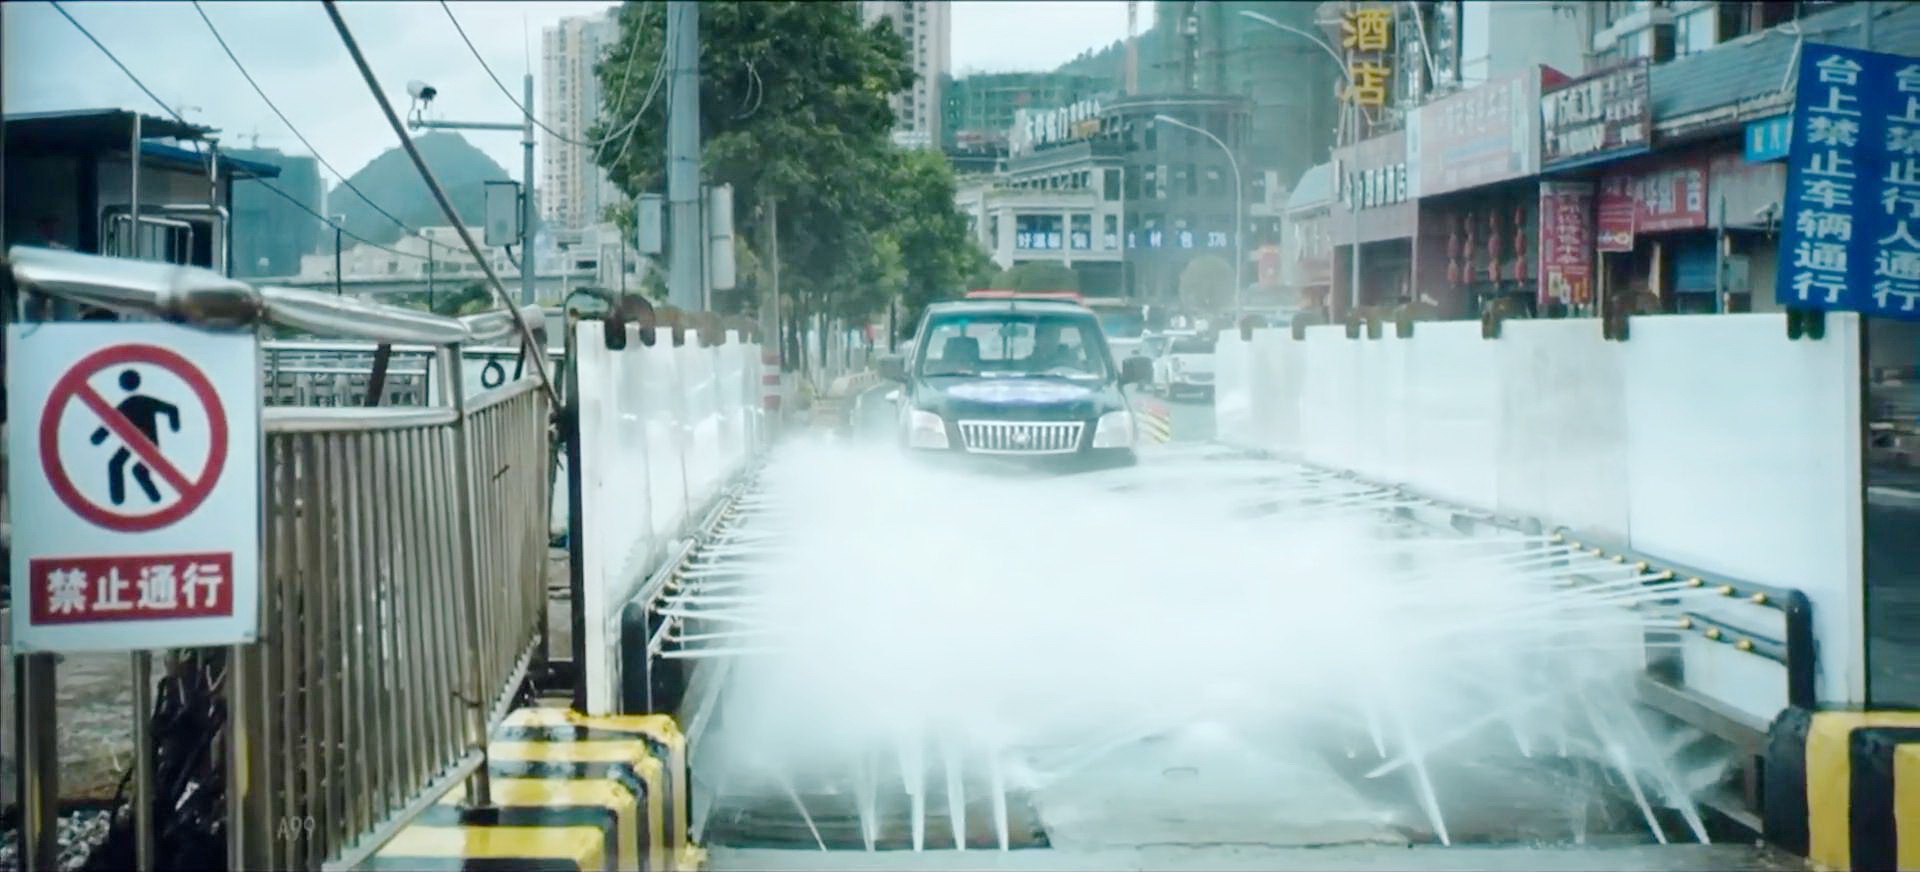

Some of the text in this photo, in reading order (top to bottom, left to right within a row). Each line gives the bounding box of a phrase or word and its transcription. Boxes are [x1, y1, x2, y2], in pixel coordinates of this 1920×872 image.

[1343, 8, 1391, 105] 酒店
[1792, 55, 1863, 303] 台上禁止车辆通行
[1872, 64, 1920, 312] 台上禁止行人通行
[47, 562, 224, 614] 禁止通行
